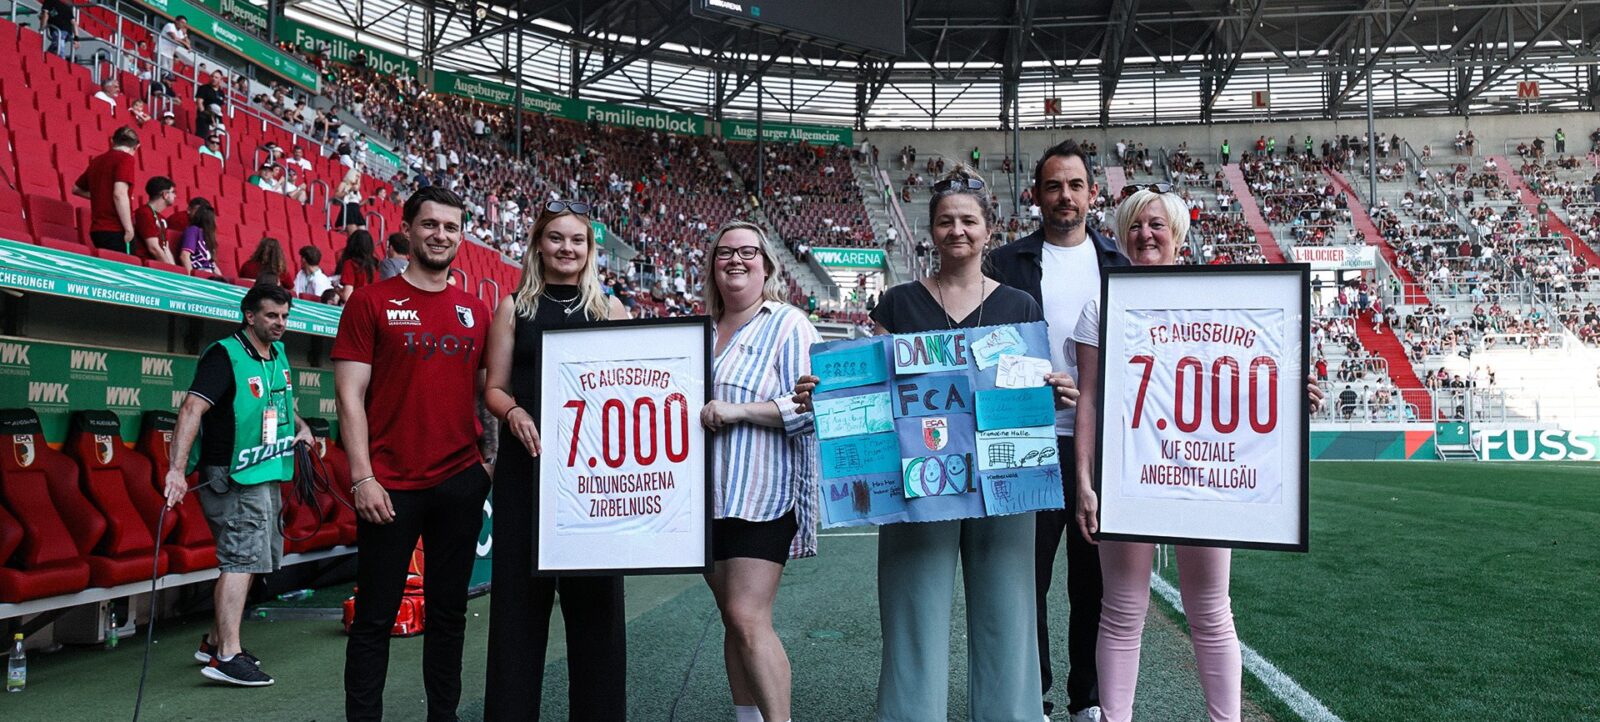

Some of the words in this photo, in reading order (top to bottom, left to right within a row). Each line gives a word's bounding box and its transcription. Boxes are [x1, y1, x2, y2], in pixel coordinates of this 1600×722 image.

[220, 0, 268, 29] Allgemein
[295, 28, 410, 77] Familieblock
[453, 78, 511, 101] Augsburger
[511, 91, 562, 112] lgemeine
[1256, 91, 1266, 107] L
[1519, 82, 1538, 97] M
[1045, 99, 1058, 113] K
[587, 105, 696, 134] Familienblock
[733, 125, 788, 139] Augsurger
[789, 128, 840, 141] Allgemeine
[67, 283, 89, 295] WWK
[91, 287, 160, 306] VERSICHERUNGEN
[169, 300, 186, 311] WWK
[187, 302, 239, 319] VERSICHERUNGEN
[386, 309, 419, 321] WWK
[1149, 325, 1169, 345] FC
[1172, 322, 1256, 349] AUGSBURG
[404, 332, 474, 363] 1907
[895, 334, 967, 367] DANKE
[70, 349, 107, 371] WWK
[141, 356, 173, 376] WWK
[299, 371, 320, 387] WWK
[579, 373, 597, 391] FC
[599, 368, 671, 389] AUGSBURG
[28, 381, 69, 403] WWK
[106, 386, 140, 406] WWK
[1128, 355, 1278, 434] 7.000
[563, 392, 689, 468] 7.000
[1457, 426, 1464, 435] 2
[1161, 439, 1182, 460] KJF
[1184, 441, 1236, 462] SOZIALE
[1481, 429, 1596, 462] FUSS
[578, 471, 675, 494] BILDUNGSARENA
[904, 452, 977, 498] COOL
[1140, 464, 1205, 487] ANGEBOTE
[1208, 465, 1257, 489] ALLGÄU
[589, 495, 662, 517] ZIRBELNUSS
